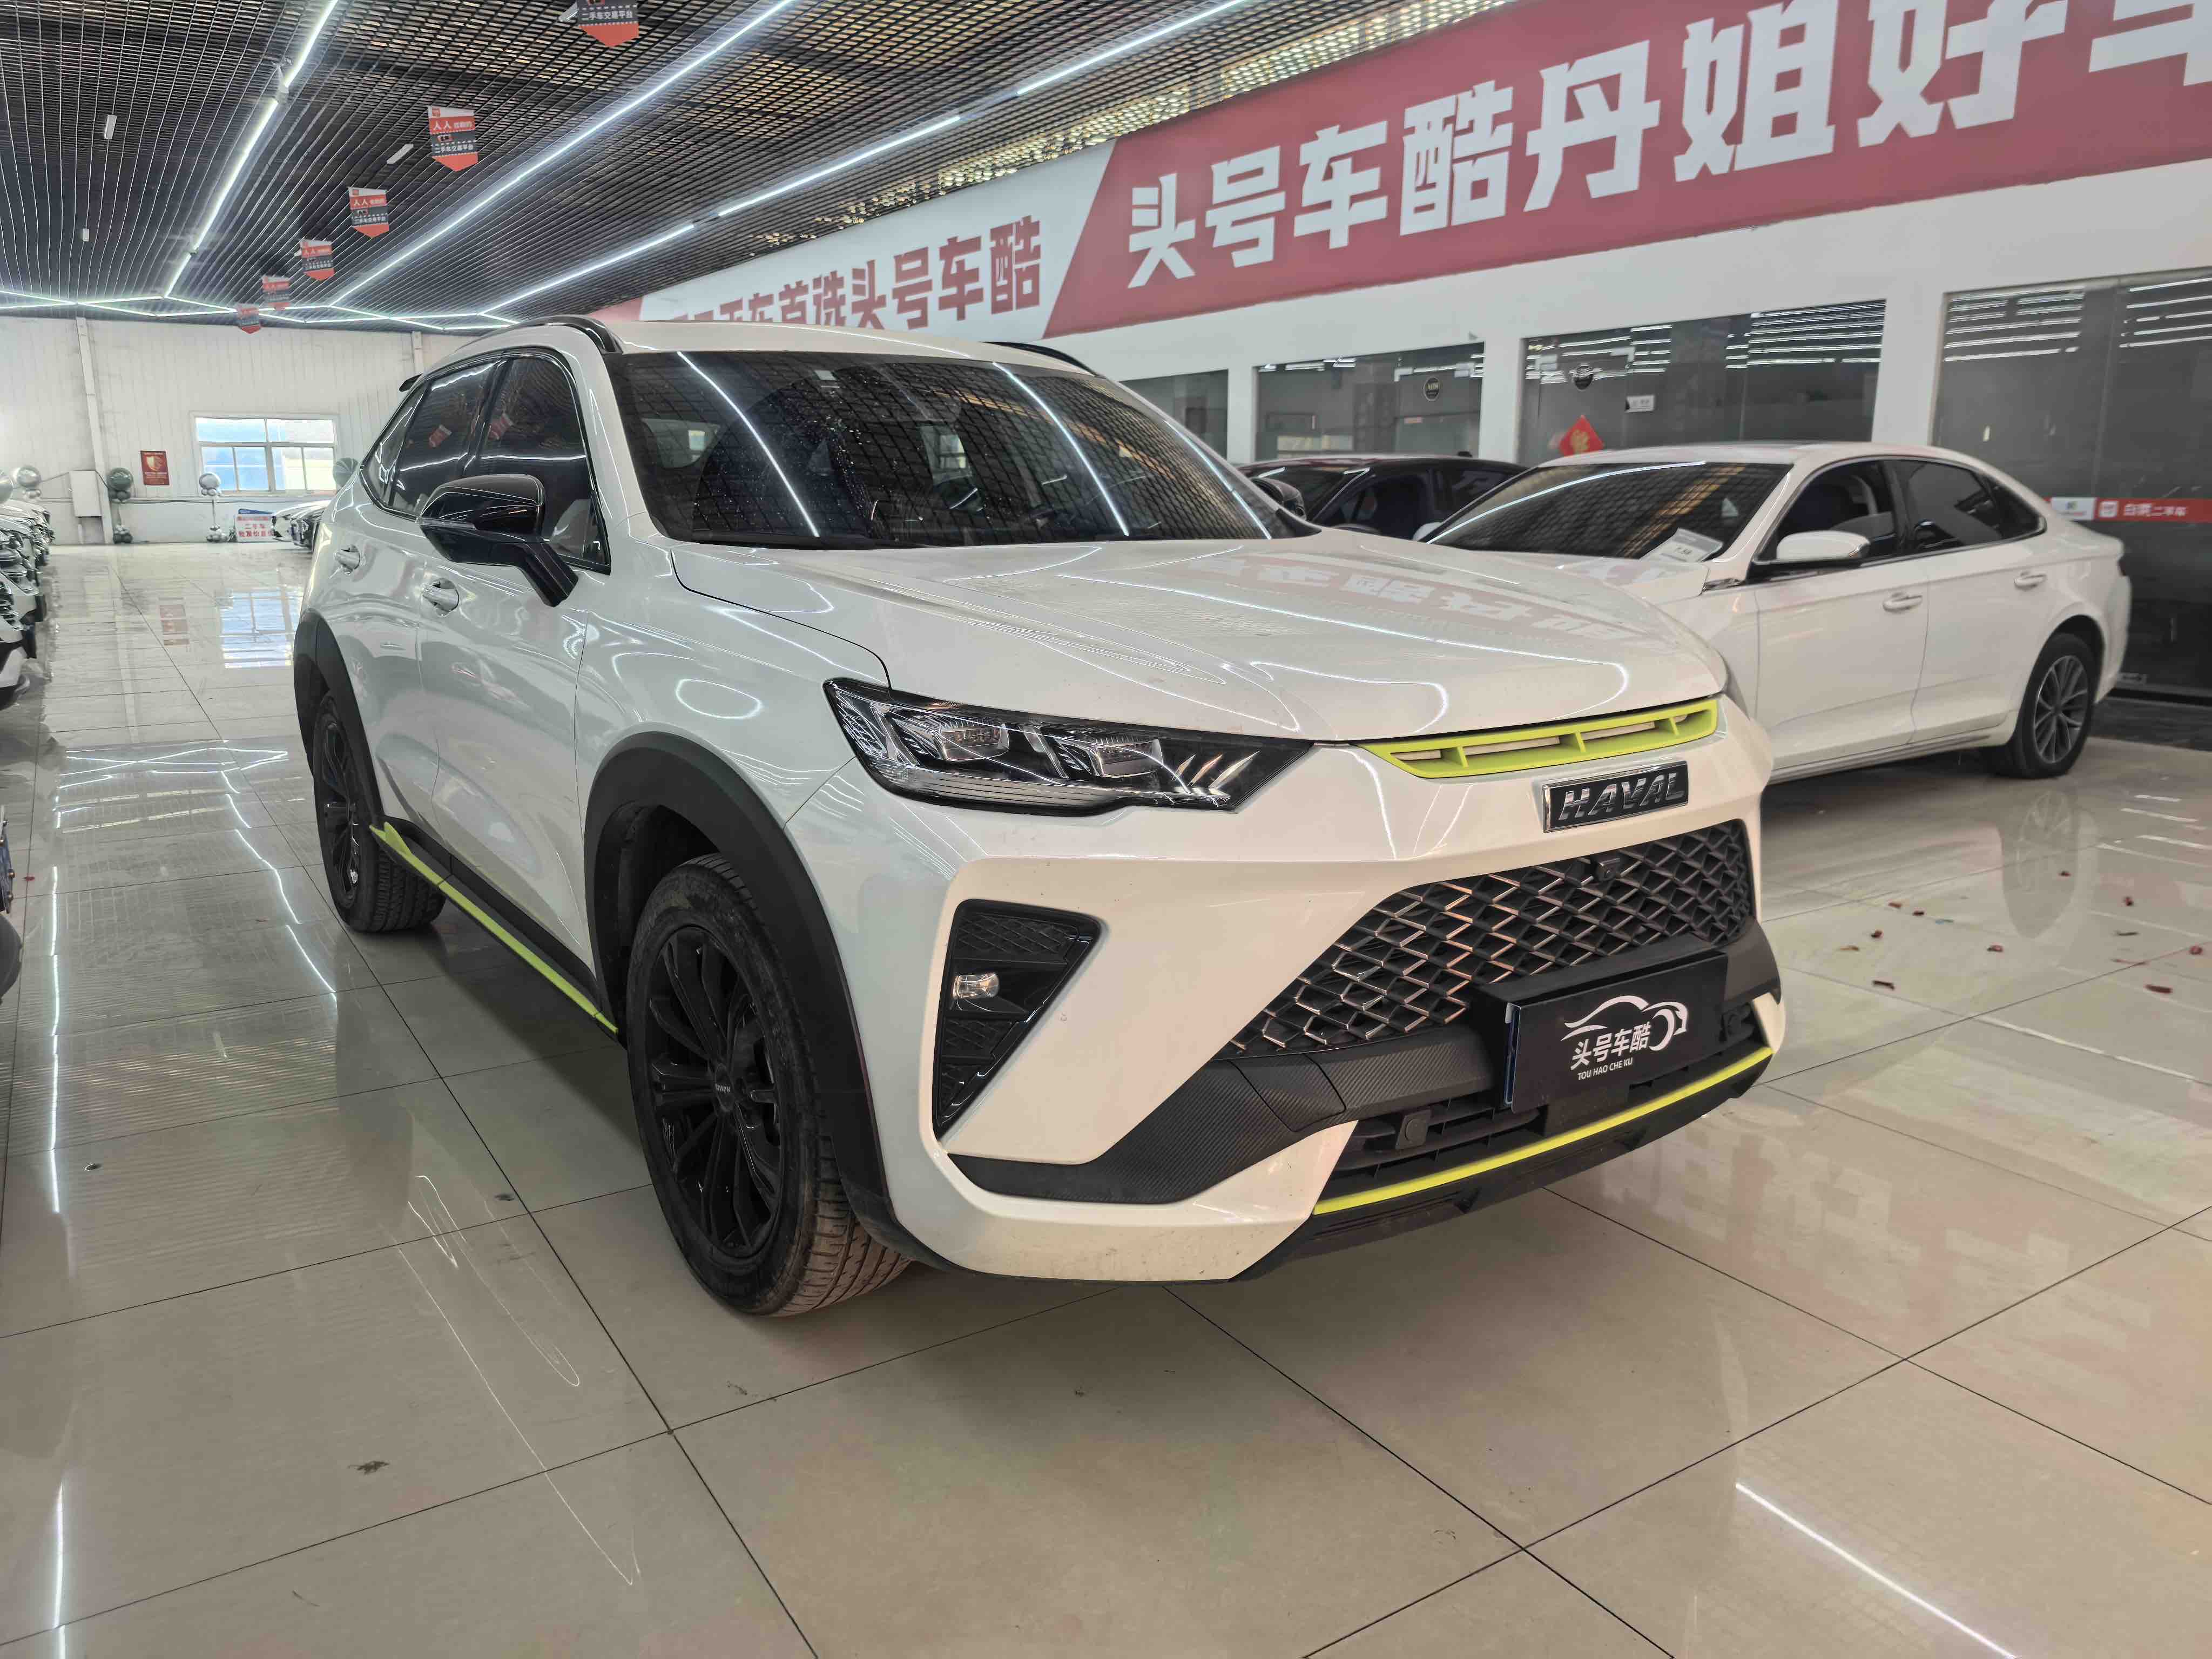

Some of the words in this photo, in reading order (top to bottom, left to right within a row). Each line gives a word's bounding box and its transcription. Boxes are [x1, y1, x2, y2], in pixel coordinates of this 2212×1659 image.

[582, 10, 632, 21] 二手车交易平台
[1559, 772, 1685, 820] HAVAL
[1570, 1021, 1651, 1071] 头号车酷
[1577, 1070, 1591, 1081] TOU
[1593, 1065, 1608, 1076] HAO
[1609, 1061, 1622, 1071] CHE
[1623, 1057, 1633, 1067] KU
